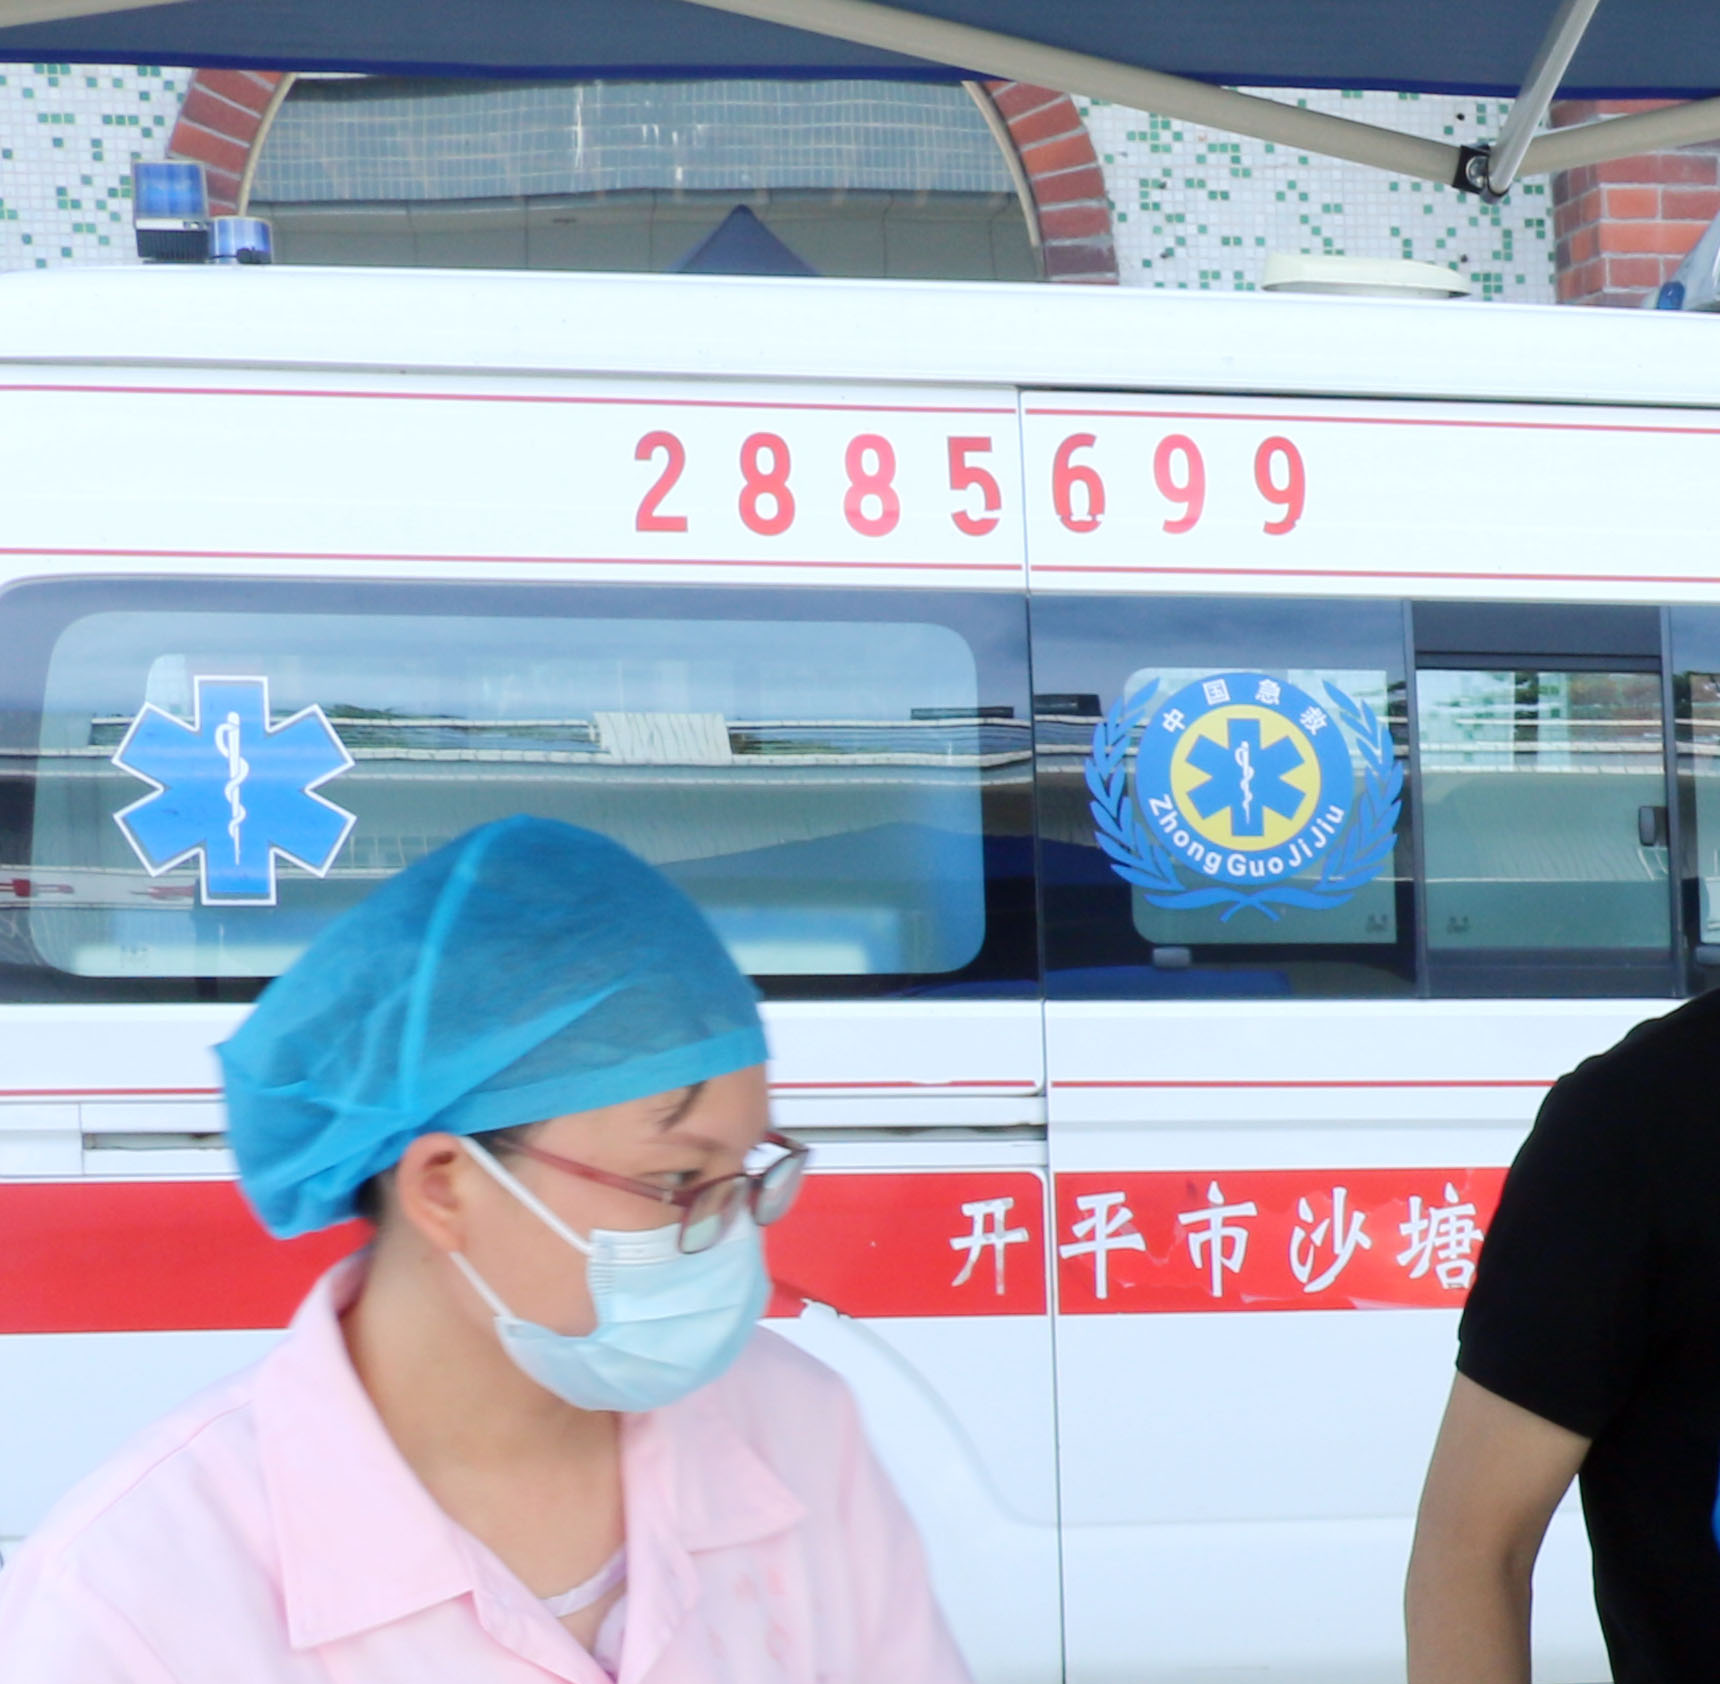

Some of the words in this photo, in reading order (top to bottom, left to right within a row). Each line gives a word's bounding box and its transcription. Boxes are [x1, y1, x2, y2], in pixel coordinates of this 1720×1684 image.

[634, 430, 1307, 538] 2885699
[1162, 678, 1329, 736] 中国急救
[949, 1180, 1485, 1300] 开平市沙塘
